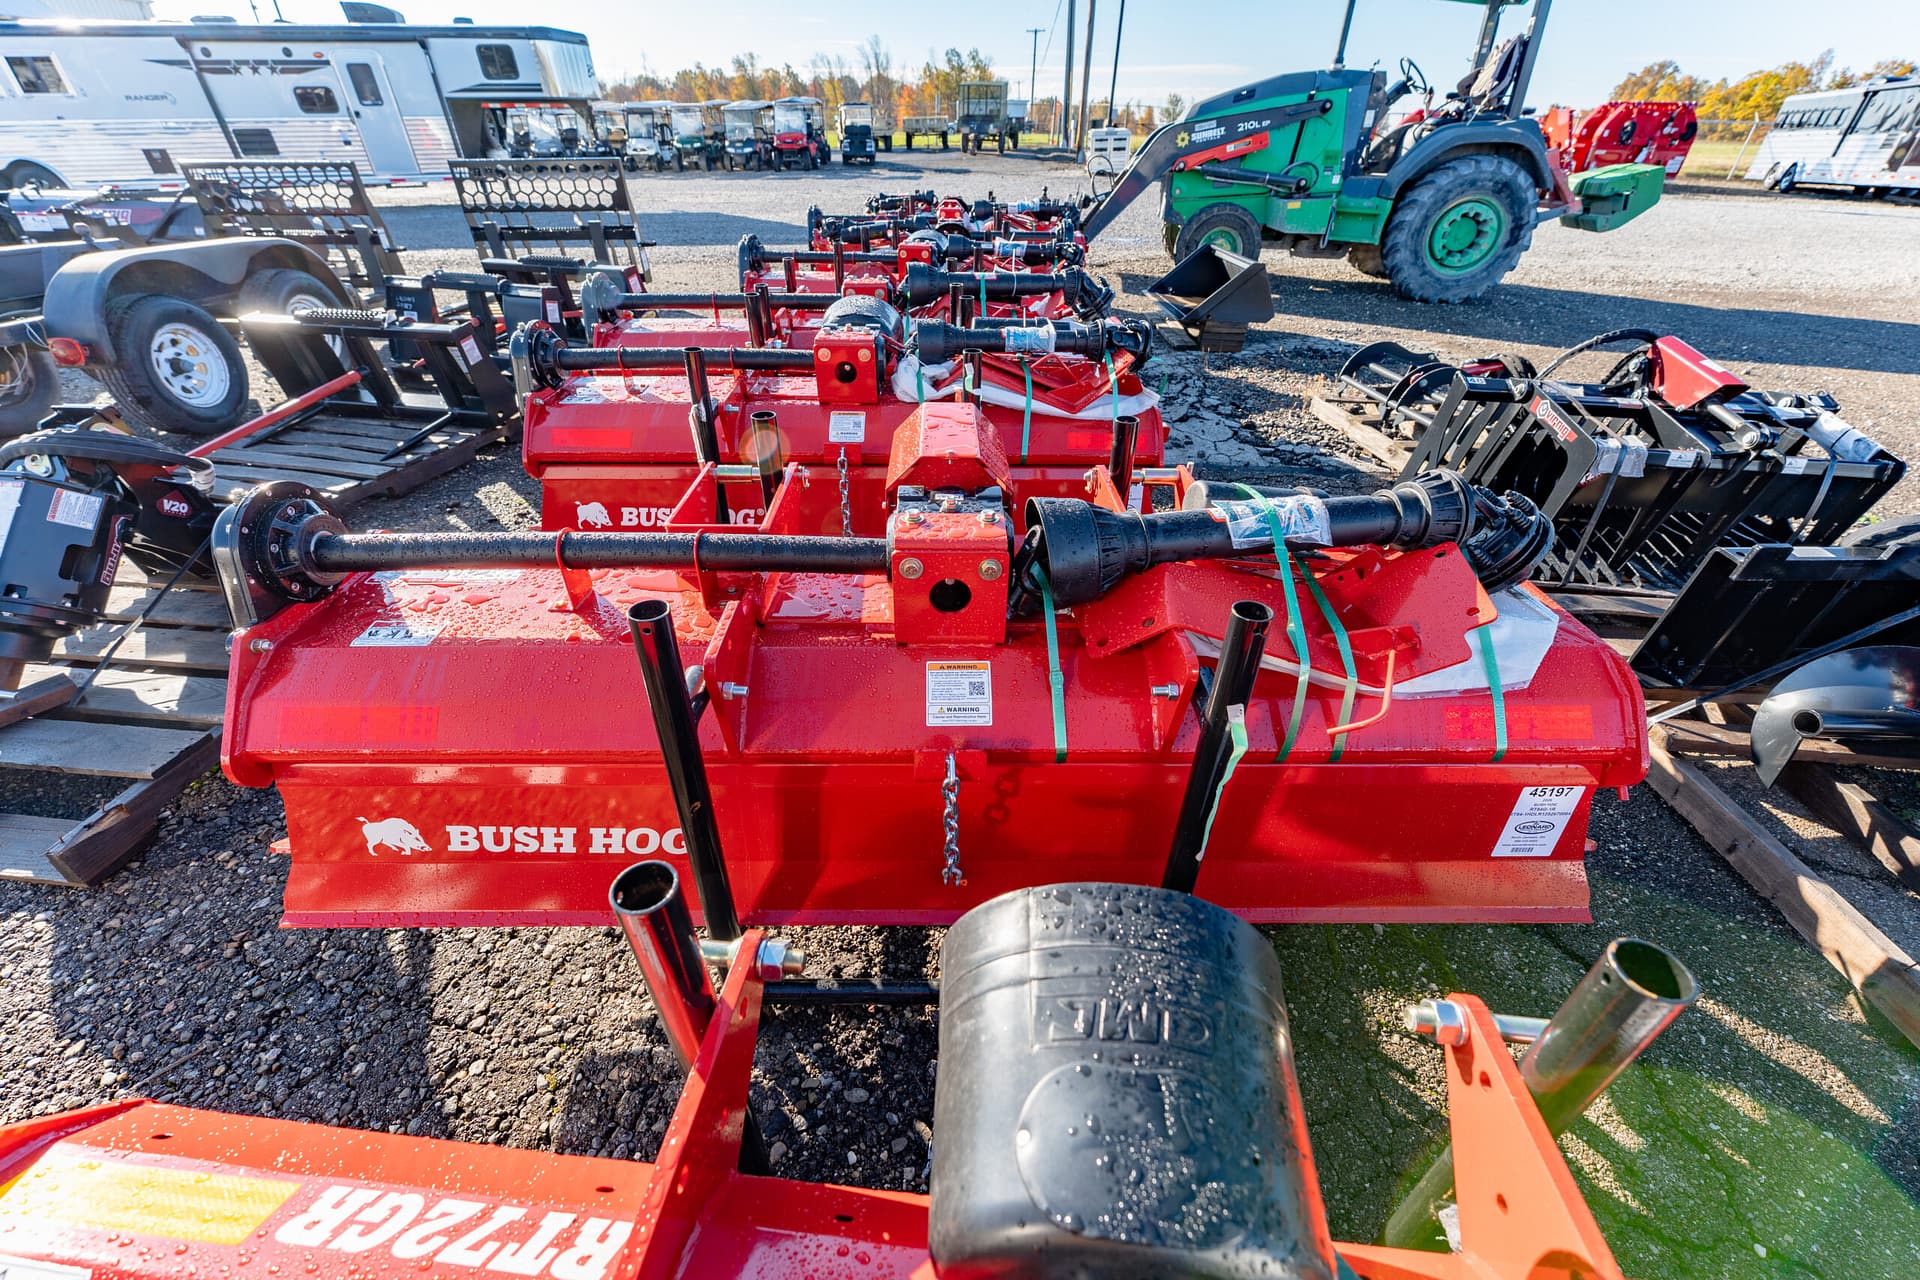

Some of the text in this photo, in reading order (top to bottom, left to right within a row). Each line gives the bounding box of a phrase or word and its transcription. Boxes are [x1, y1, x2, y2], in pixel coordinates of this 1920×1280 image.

[1191, 126, 1227, 142] SUNBELT
[1237, 120, 1261, 132] 210L
[163, 499, 189, 513] V20
[620, 507, 677, 527] BUS
[1529, 787, 1574, 797] 45197
[446, 825, 688, 854] BUSH HOG
[274, 1184, 635, 1280] RT72GR
